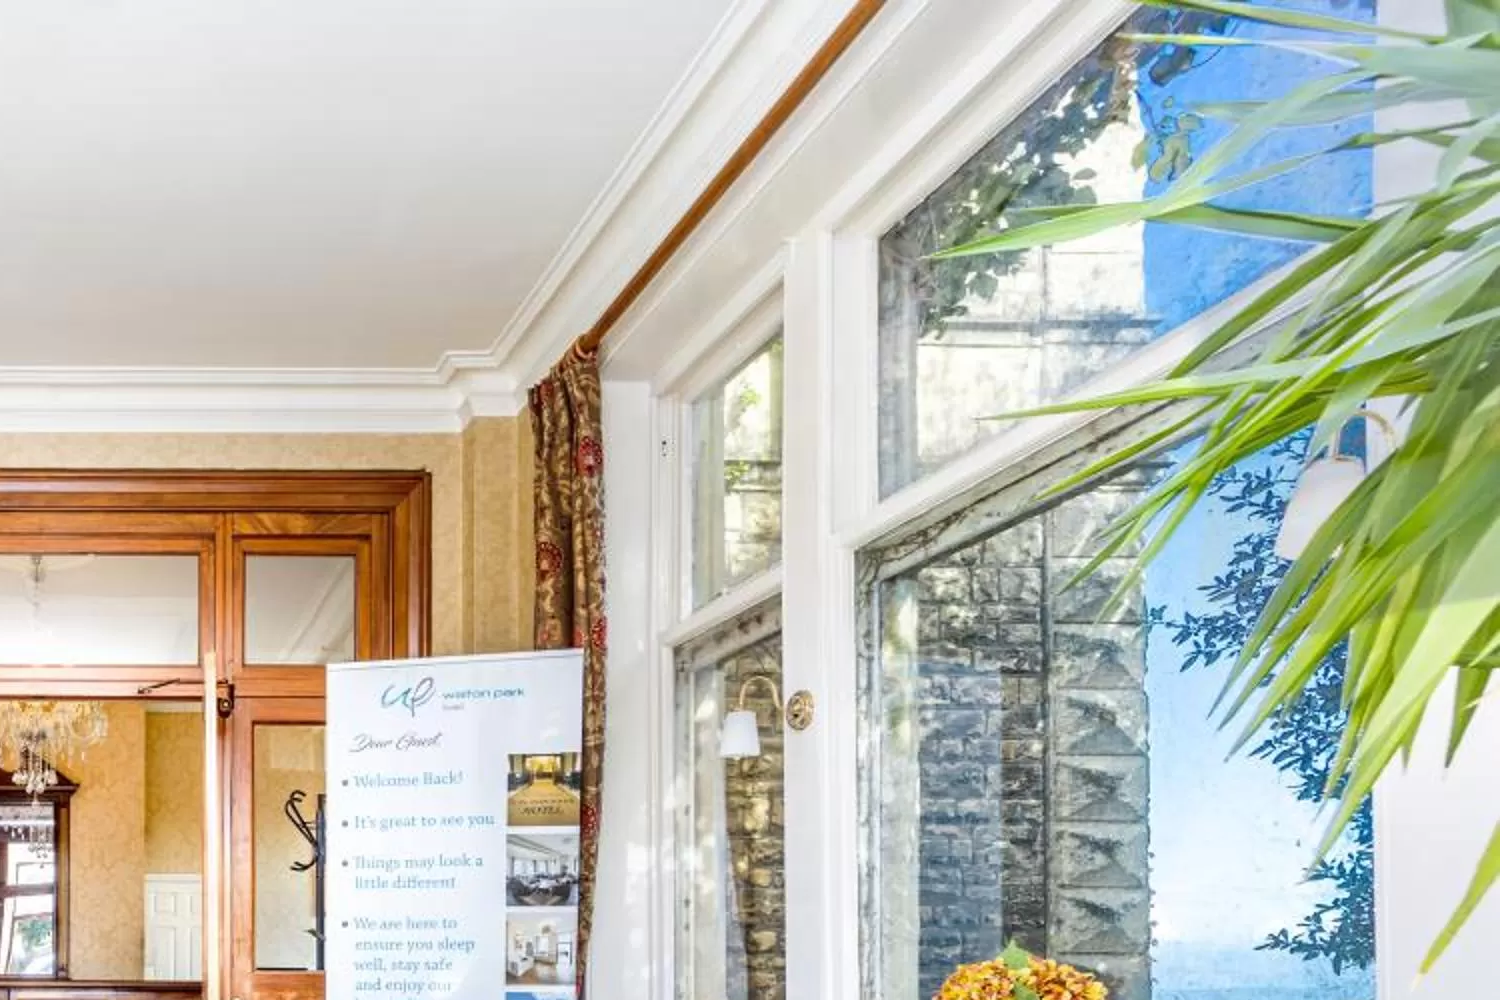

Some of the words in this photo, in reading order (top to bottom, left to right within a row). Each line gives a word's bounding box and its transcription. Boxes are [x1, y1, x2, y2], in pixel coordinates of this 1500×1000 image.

[493, 686, 525, 700] park
[353, 773, 419, 788] Welcome
[422, 770, 464, 786] Back!
[354, 814, 376, 829] It's
[379, 815, 417, 832] great
[420, 814, 436, 827] to
[440, 815, 466, 827] see
[468, 815, 496, 830] you
[353, 854, 401, 872] Things
[404, 858, 436, 872] may
[438, 853, 473, 868] look
[475, 858, 484, 867] a
[354, 875, 389, 890] little
[392, 875, 456, 890] different
[353, 917, 376, 930] We
[378, 920, 400, 930] are
[405, 916, 437, 930] here
[441, 917, 458, 930] to
[354, 939, 403, 951] ensure
[407, 941, 433, 954] you
[437, 936, 476, 954] sleep
[353, 957, 388, 973] well,
[391, 959, 420, 975] stay
[423, 957, 453, 971] safe
[354, 978, 382, 992] and
[385, 980, 423, 994] enjoy
